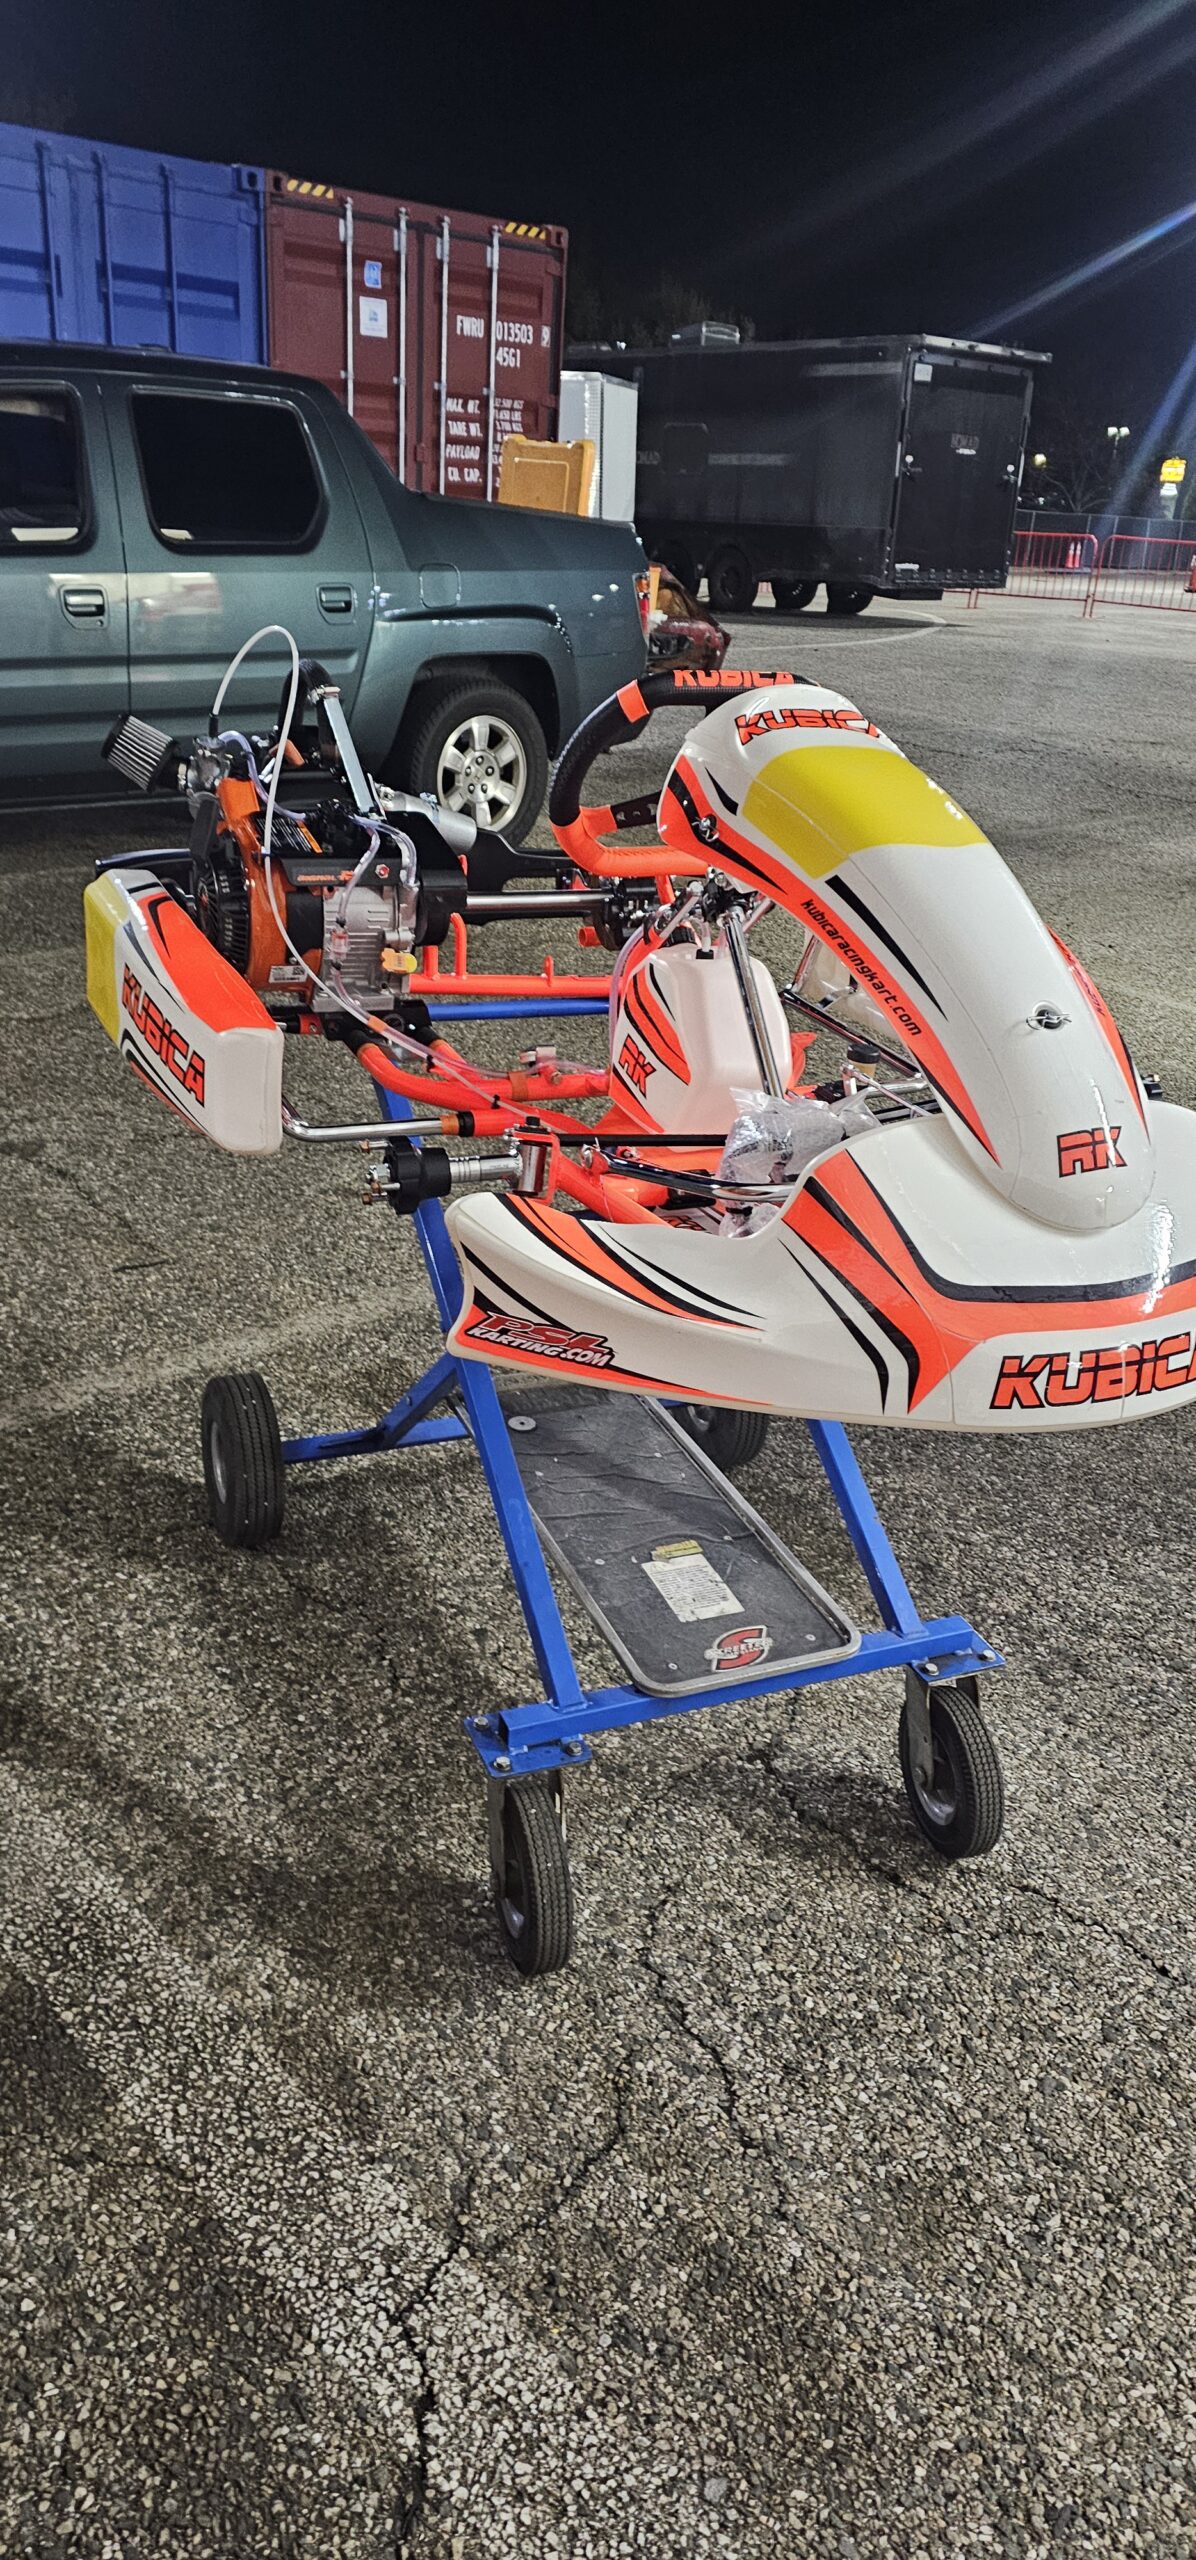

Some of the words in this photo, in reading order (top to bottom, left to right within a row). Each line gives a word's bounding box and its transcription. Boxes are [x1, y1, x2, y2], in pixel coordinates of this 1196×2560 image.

[456, 314, 485, 339] FWRU
[496, 320, 534, 345] 013503
[448, 420, 468, 438] TARE
[446, 444, 480, 460] PAYLOAD
[801, 899, 923, 1036] kubicaracingkart.com
[121, 961, 206, 1109] KUBICA
[618, 1033, 657, 1100] RK
[1057, 1126, 1128, 1178] RK
[467, 1327, 613, 1367] KARTING.COM
[479, 1311, 609, 1354] PSL
